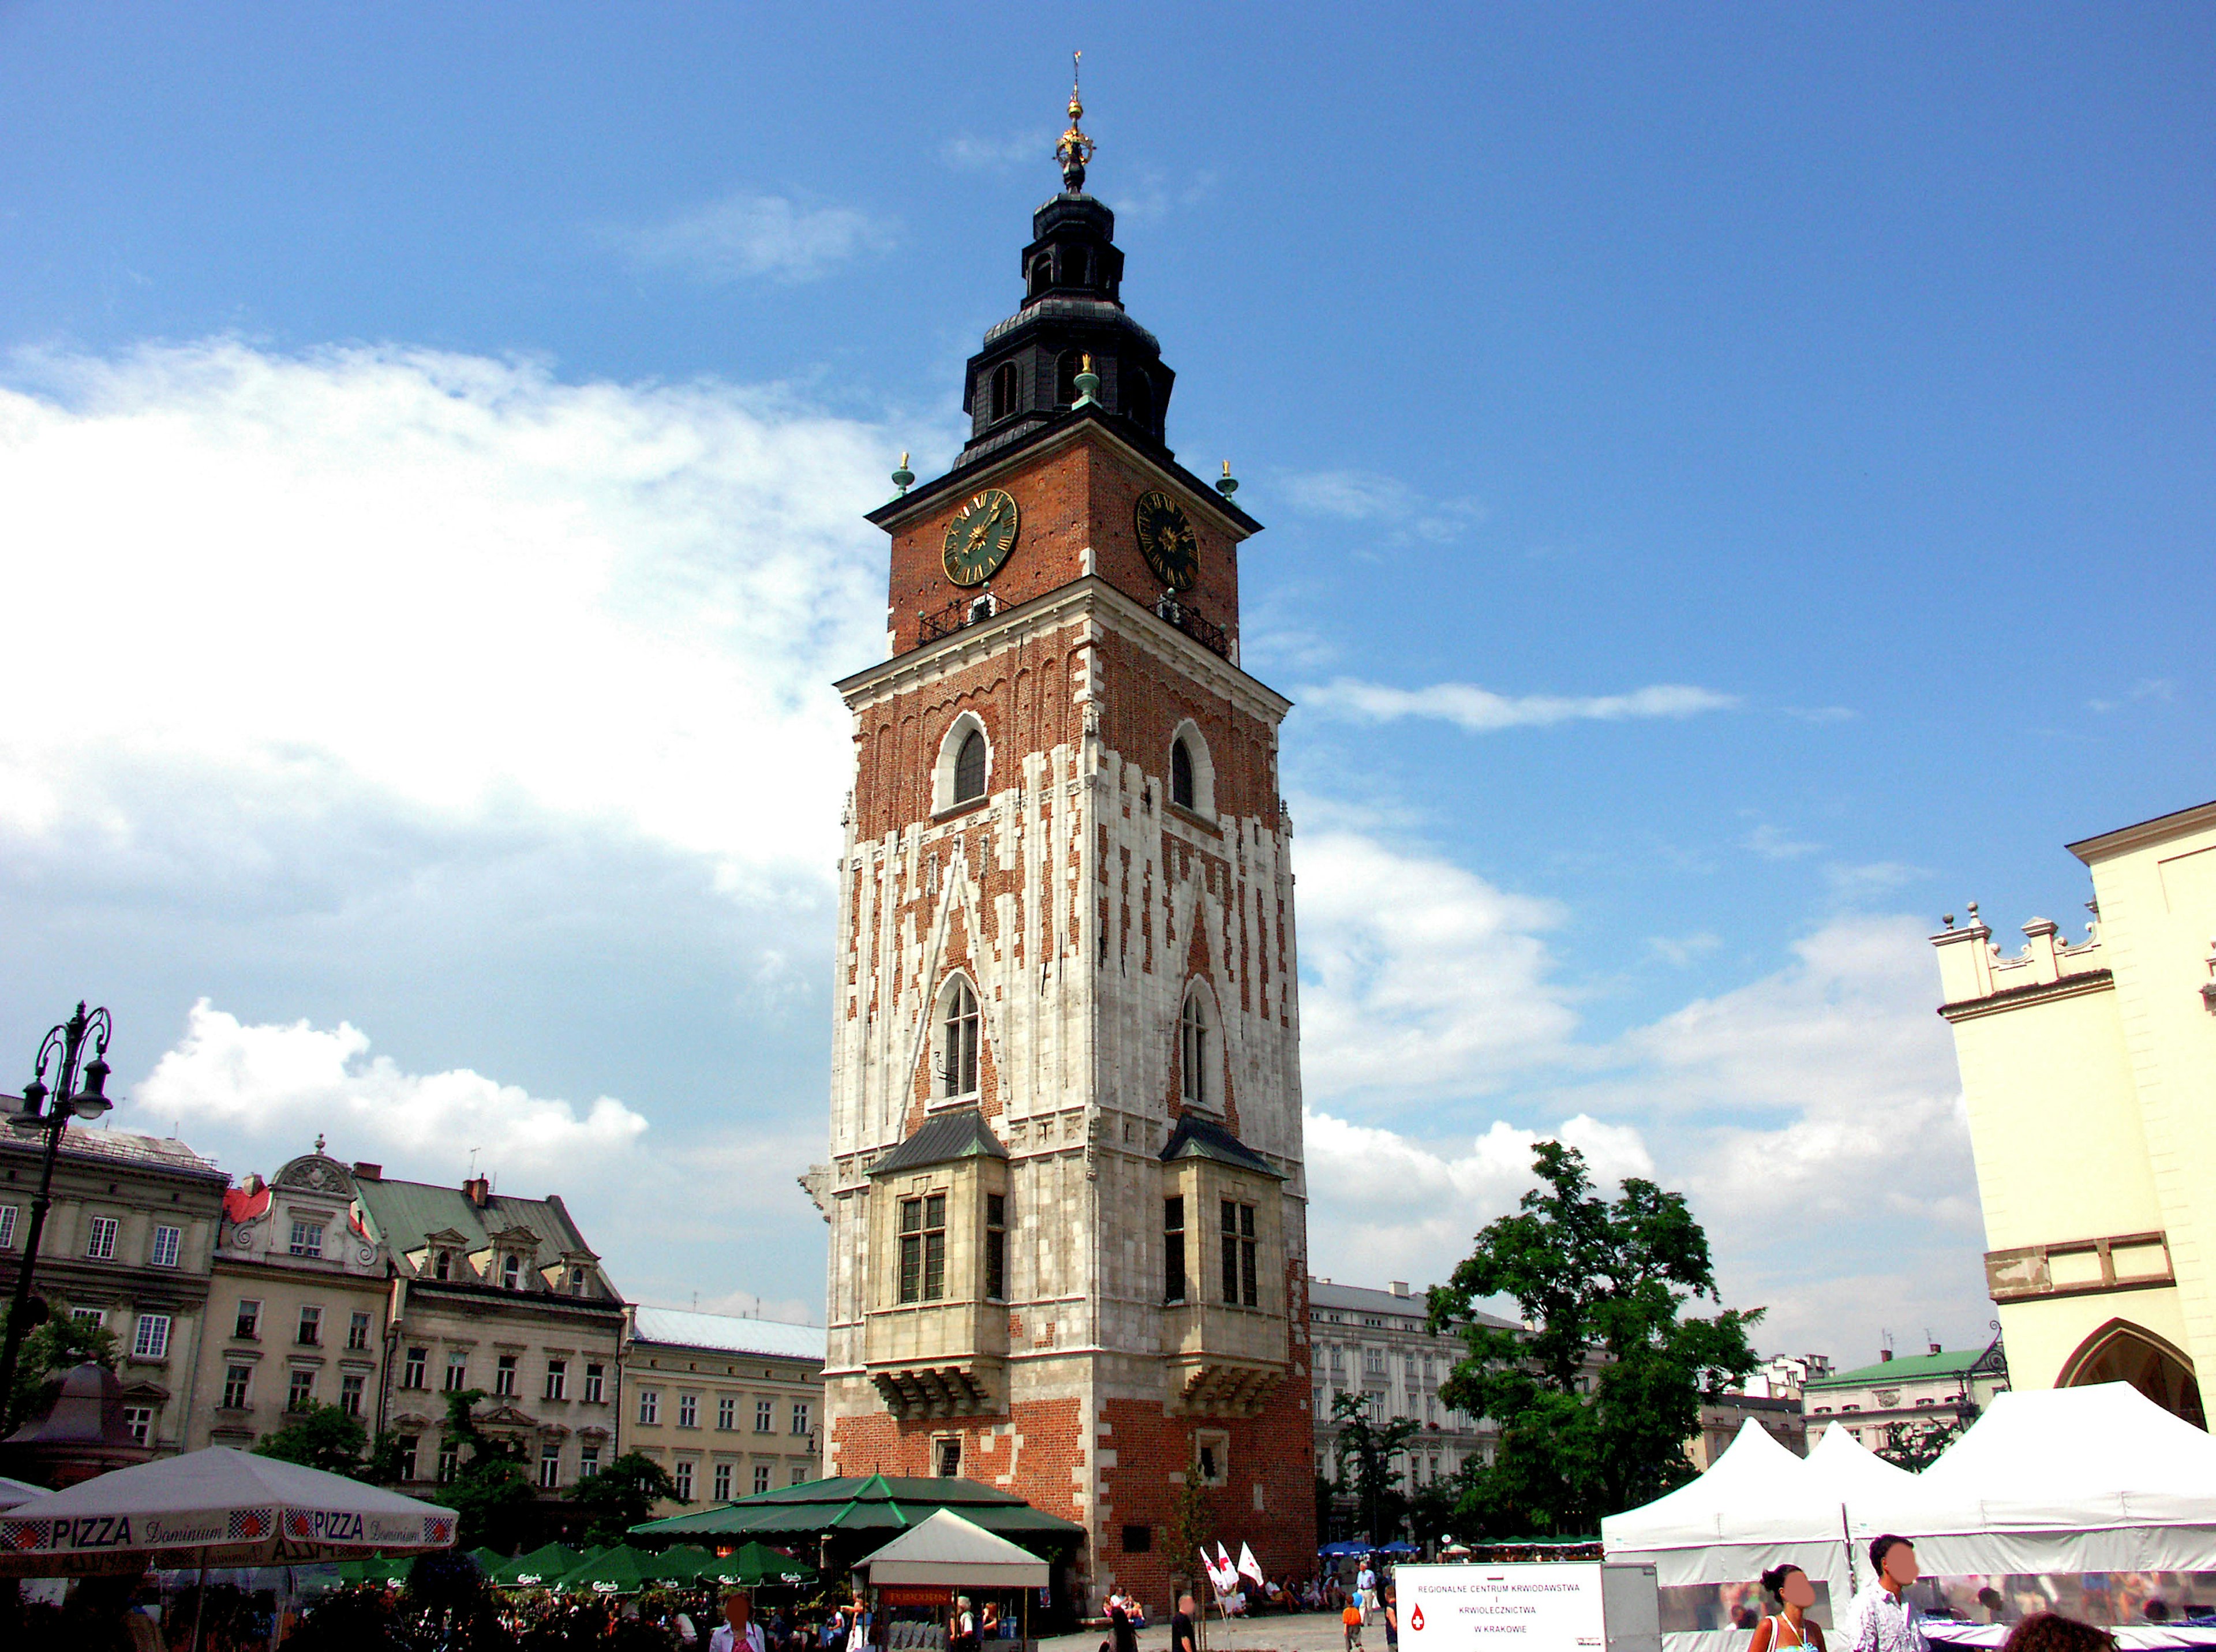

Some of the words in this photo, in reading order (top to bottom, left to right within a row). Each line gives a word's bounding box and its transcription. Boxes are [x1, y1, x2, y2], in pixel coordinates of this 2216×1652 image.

[51, 1516, 132, 1549] PIZZA
[144, 1520, 223, 1544] Dominium
[315, 1511, 363, 1539] PIZZA
